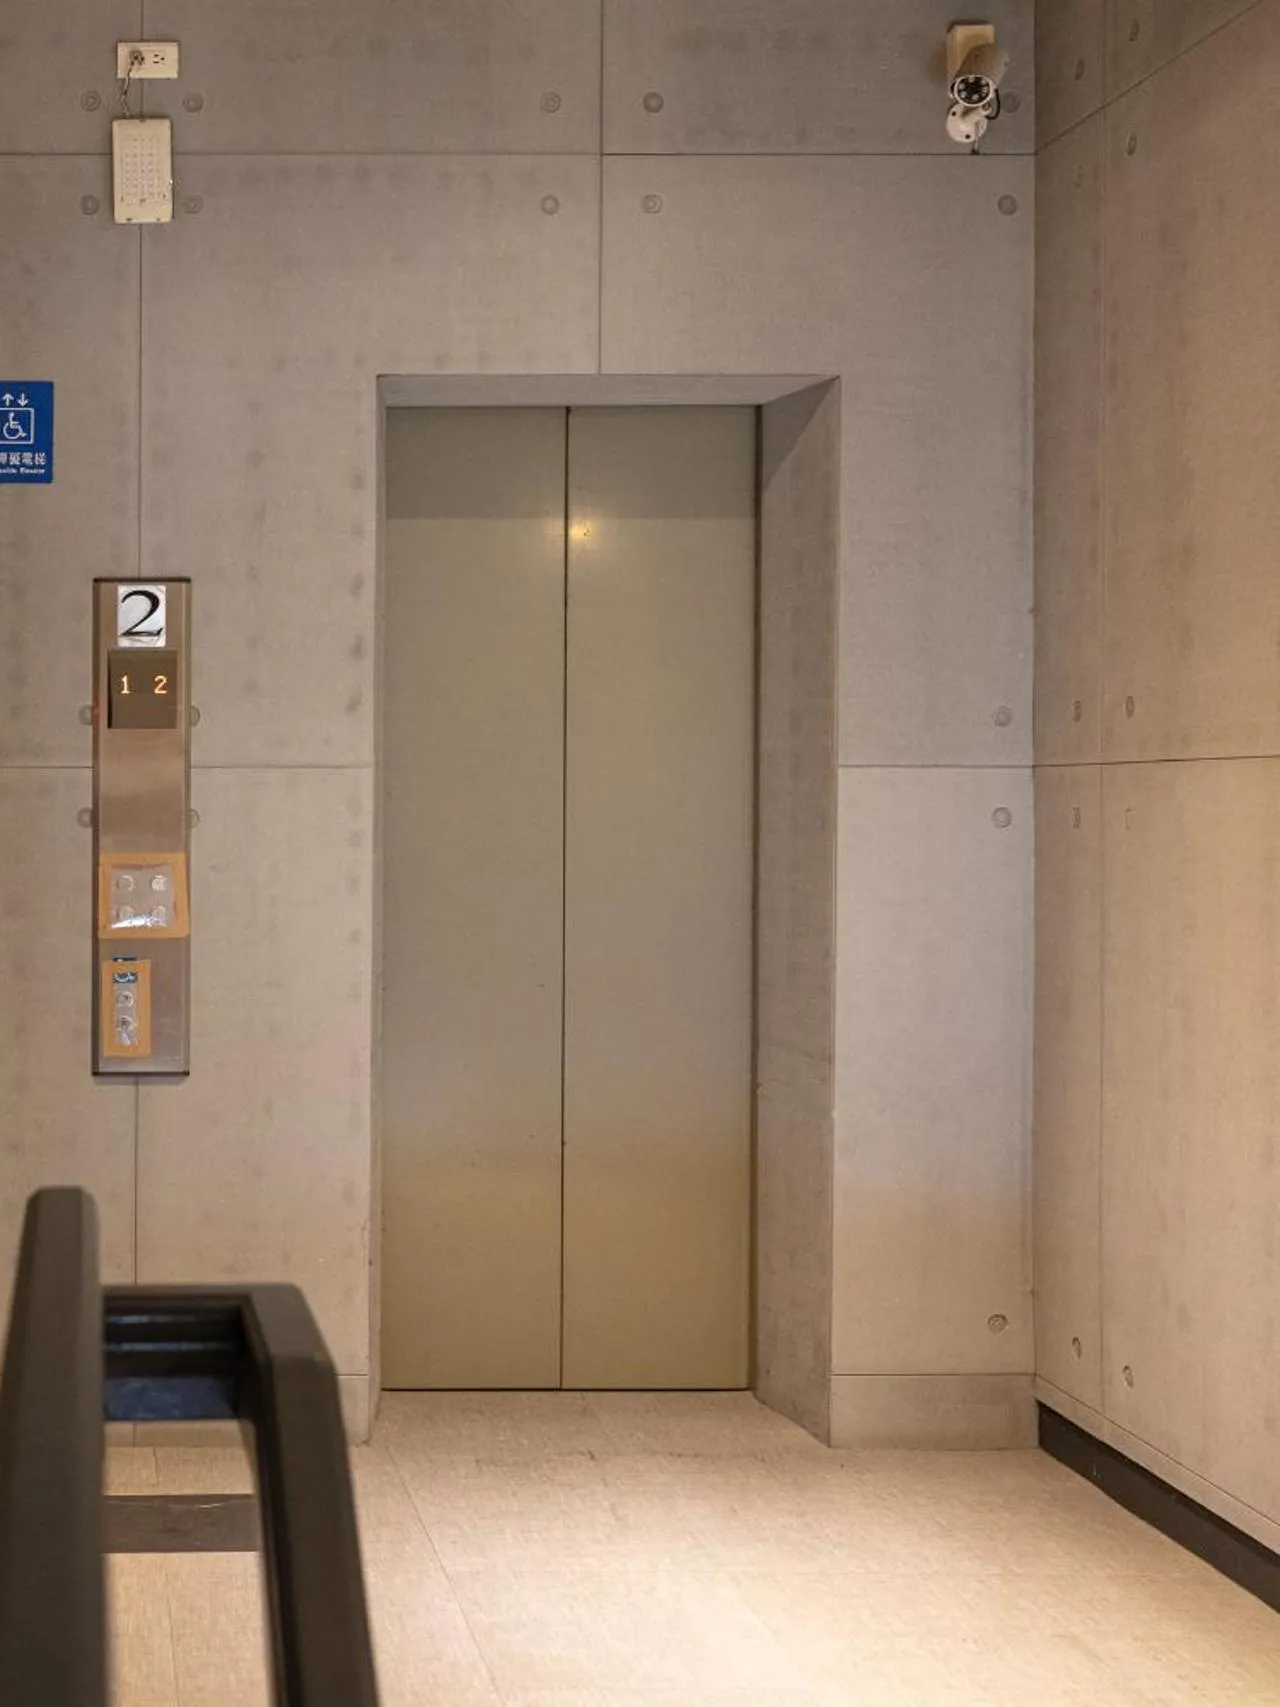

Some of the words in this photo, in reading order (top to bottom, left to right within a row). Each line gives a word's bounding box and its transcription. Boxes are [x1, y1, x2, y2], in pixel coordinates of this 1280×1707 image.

[120, 590, 163, 637] 2
[121, 675, 131, 694] 1
[154, 675, 167, 694] 2
